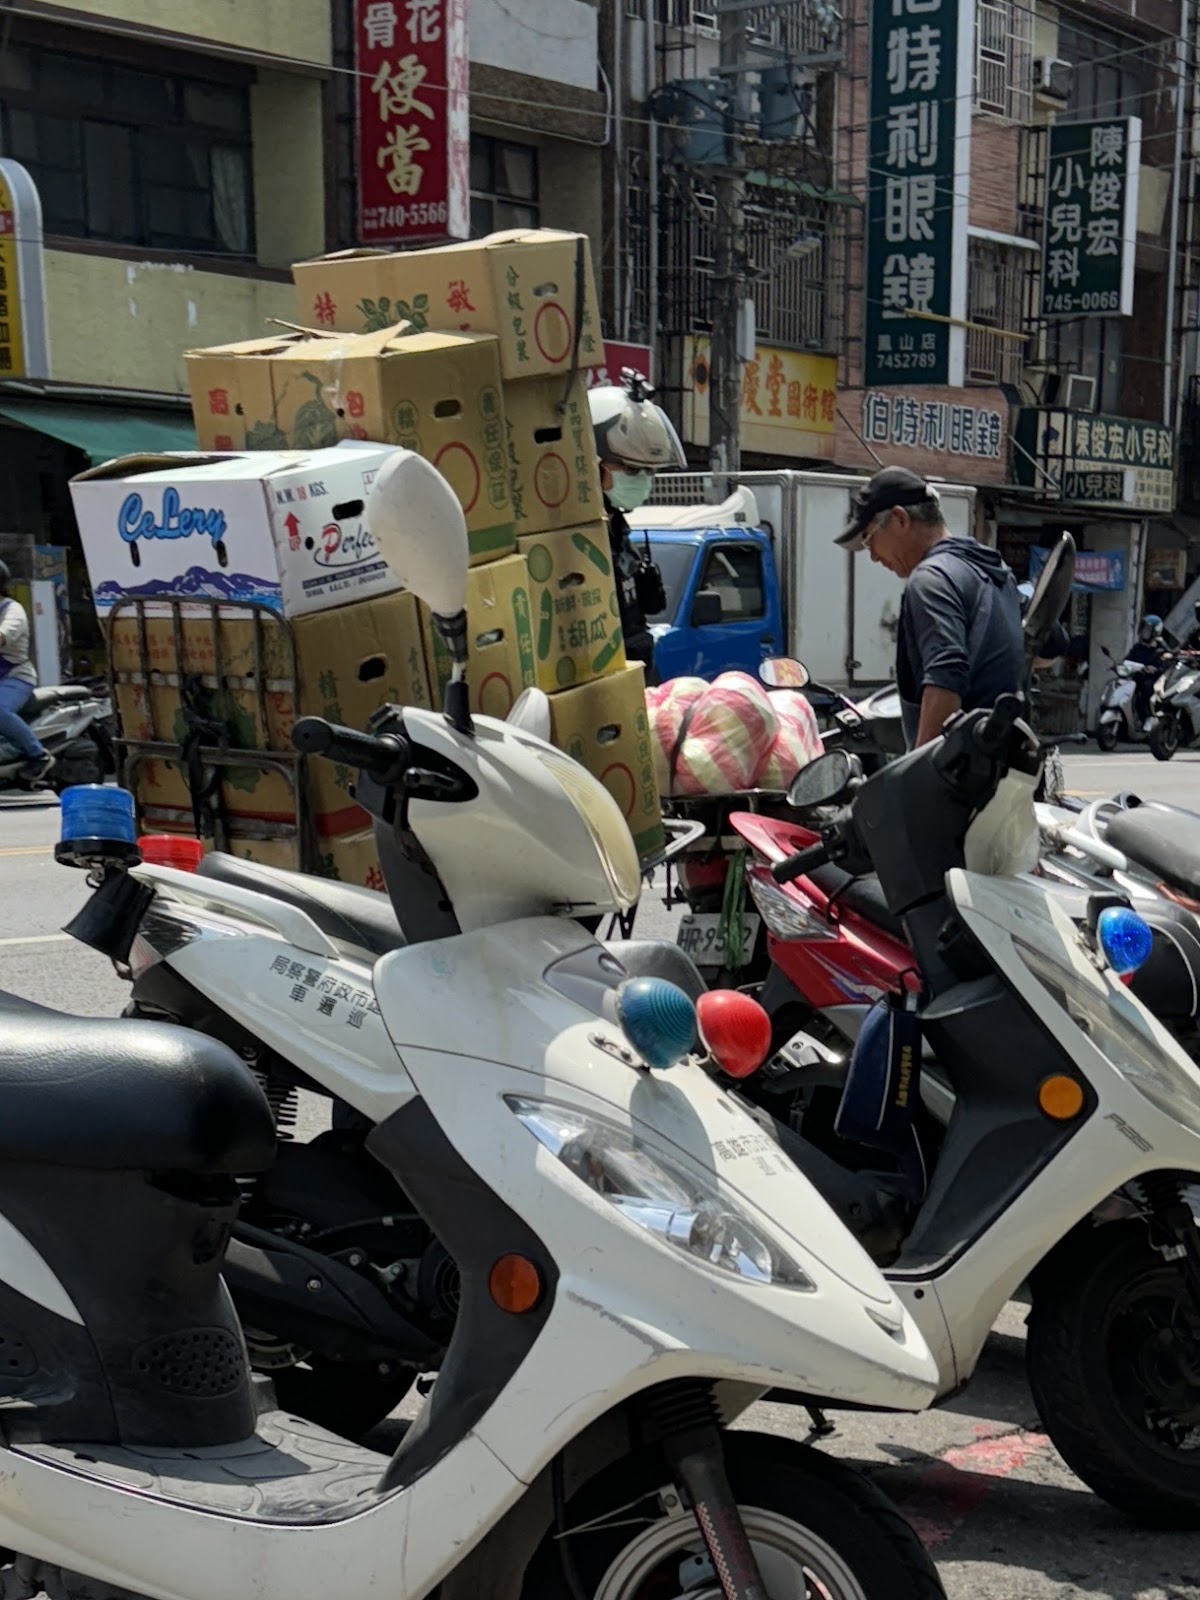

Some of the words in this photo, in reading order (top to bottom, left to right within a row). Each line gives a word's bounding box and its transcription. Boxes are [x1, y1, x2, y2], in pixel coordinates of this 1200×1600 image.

[371, 54, 435, 196] 便當
[1048, 157, 1085, 288] 小兒科
[1086, 126, 1124, 256] 陳俊宏
[1045, 290, 1119, 312] 745-0066
[876, 353, 936, 368] 7452789
[863, 391, 1001, 459] 伯特利眼鏡
[1066, 473, 1123, 499] 小兒科
